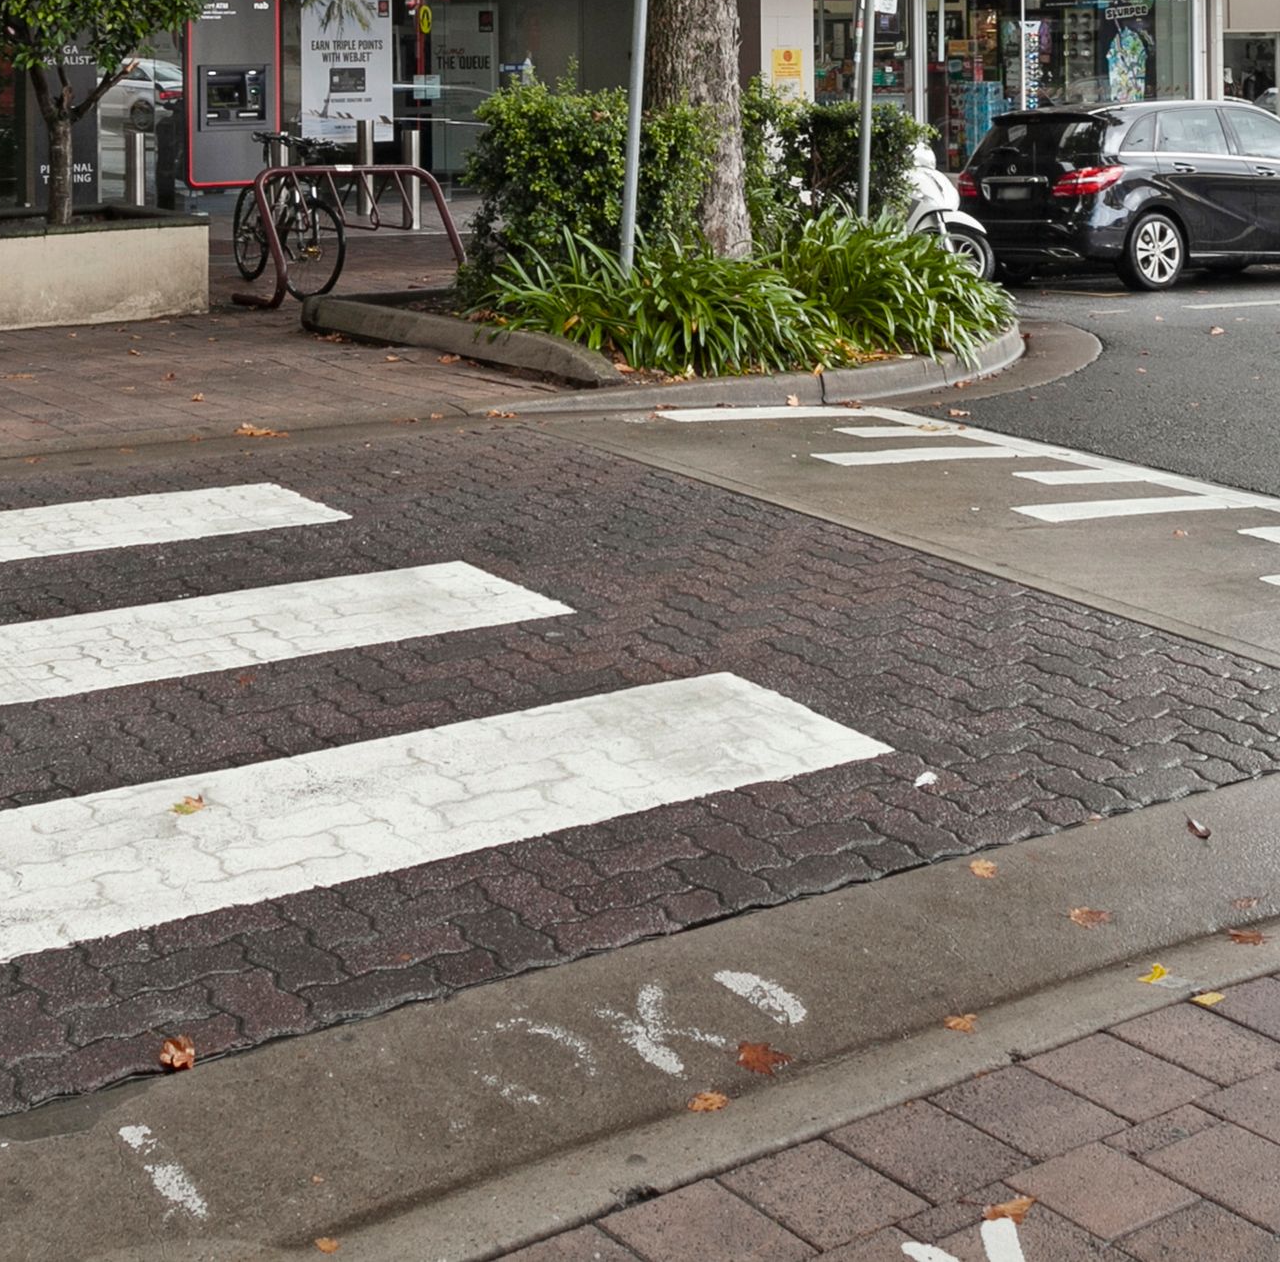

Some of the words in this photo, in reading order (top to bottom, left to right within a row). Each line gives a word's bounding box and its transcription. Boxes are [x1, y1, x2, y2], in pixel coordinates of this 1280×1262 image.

[48, 45, 79, 55] YGA
[311, 40, 330, 51] EARN
[332, 40, 356, 51] TRIPLE
[358, 39, 384, 51] POINTS
[322, 52, 341, 63] WITH
[437, 56, 455, 70] THE
[458, 56, 491, 70] QUEUE
